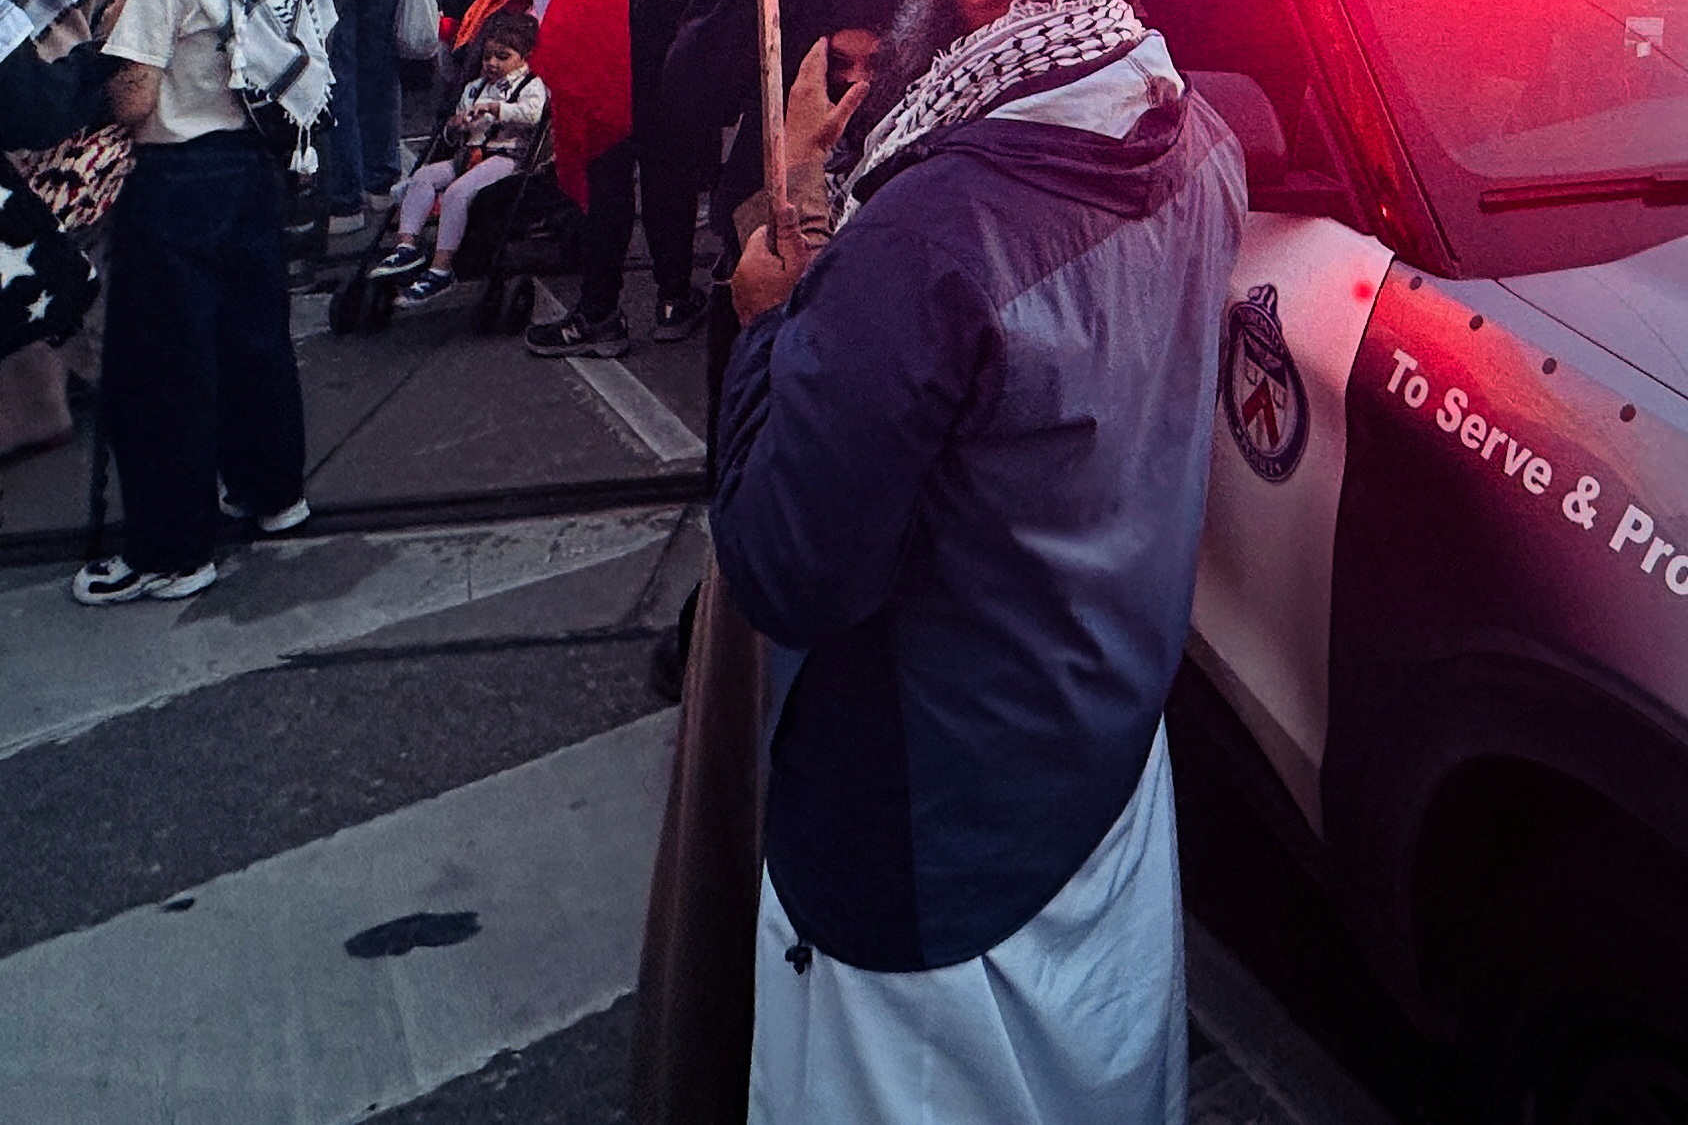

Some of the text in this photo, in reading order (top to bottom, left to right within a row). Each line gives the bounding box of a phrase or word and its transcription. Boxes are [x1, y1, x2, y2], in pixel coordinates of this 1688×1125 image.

[1384, 348, 1429, 409] To
[1436, 386, 1553, 495] Serve
[1562, 475, 1601, 531] &
